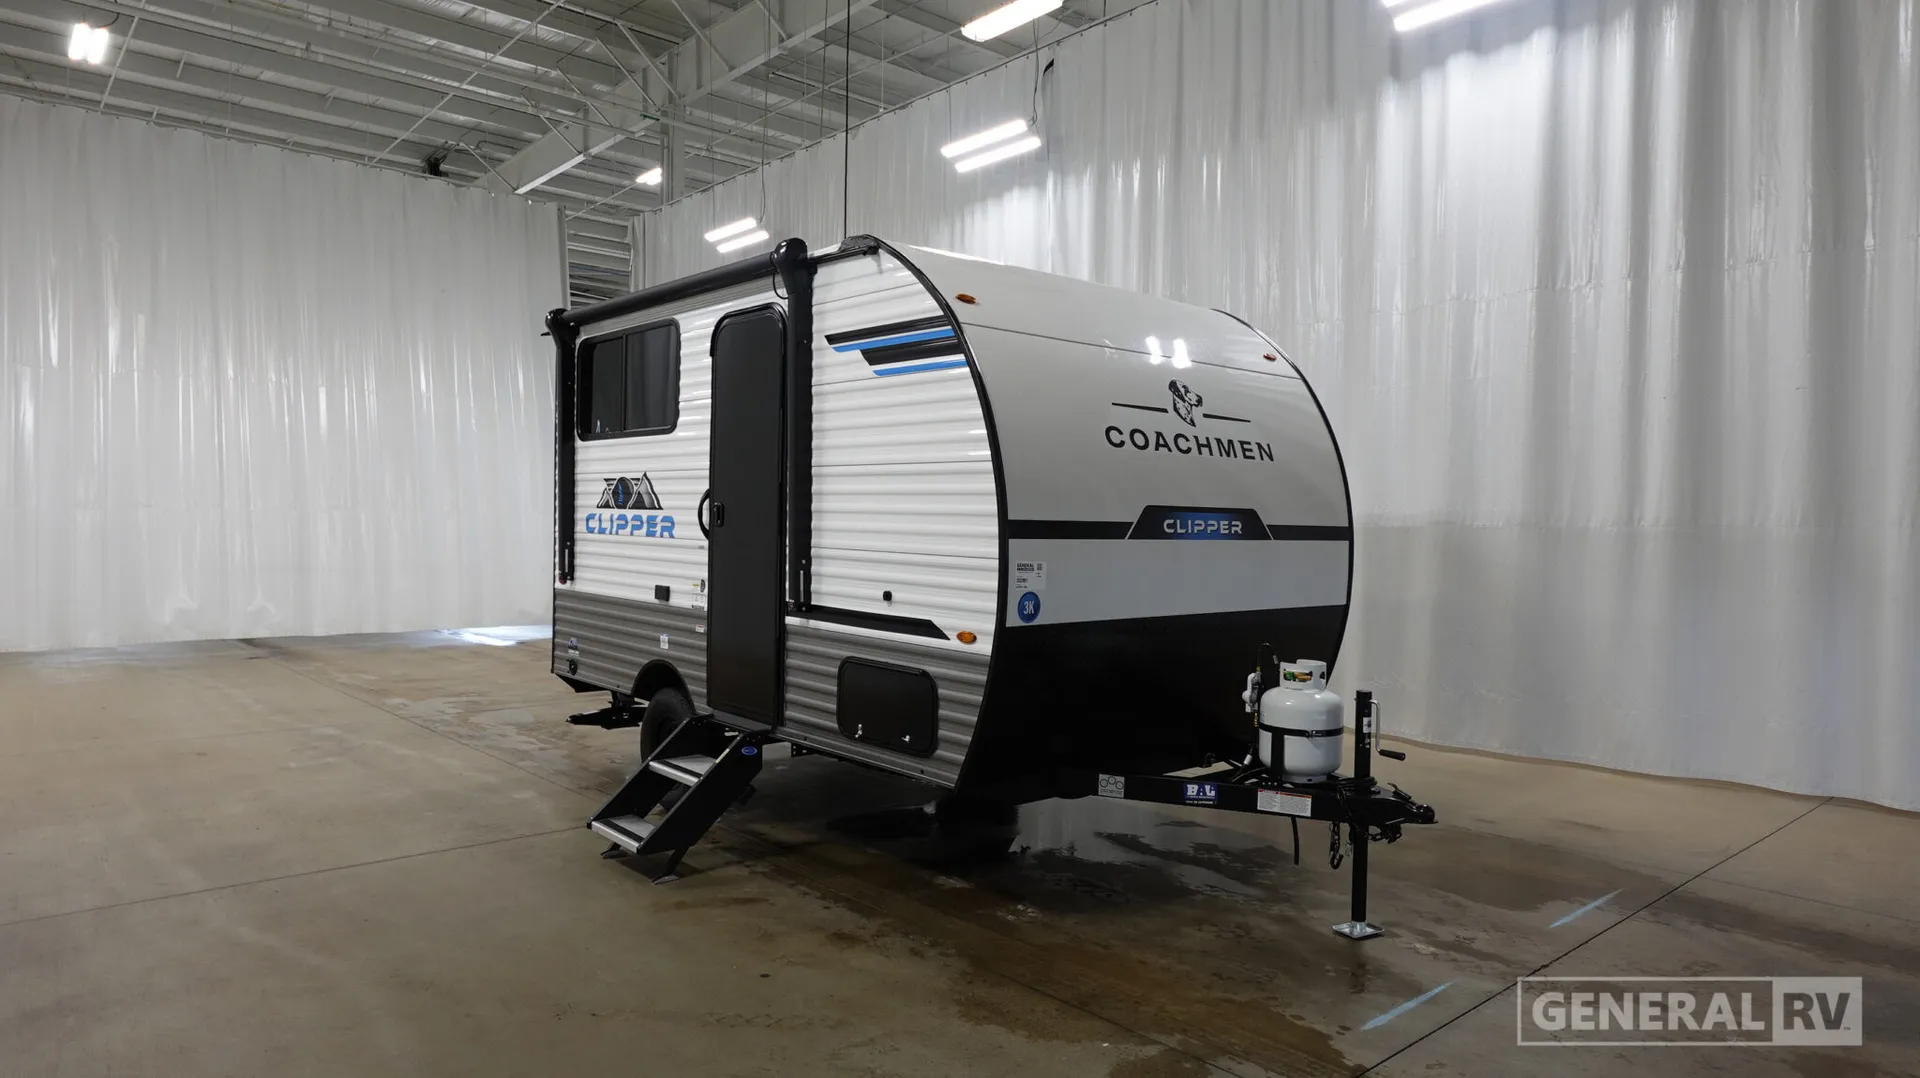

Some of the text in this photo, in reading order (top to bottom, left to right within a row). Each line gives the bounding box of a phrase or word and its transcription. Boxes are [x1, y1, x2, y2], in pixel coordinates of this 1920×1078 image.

[1105, 425, 1275, 462] COACHMEN
[585, 513, 676, 539] CLIPPER
[1163, 519, 1242, 534] CLIPPER
[1023, 601, 1034, 614] 3K
